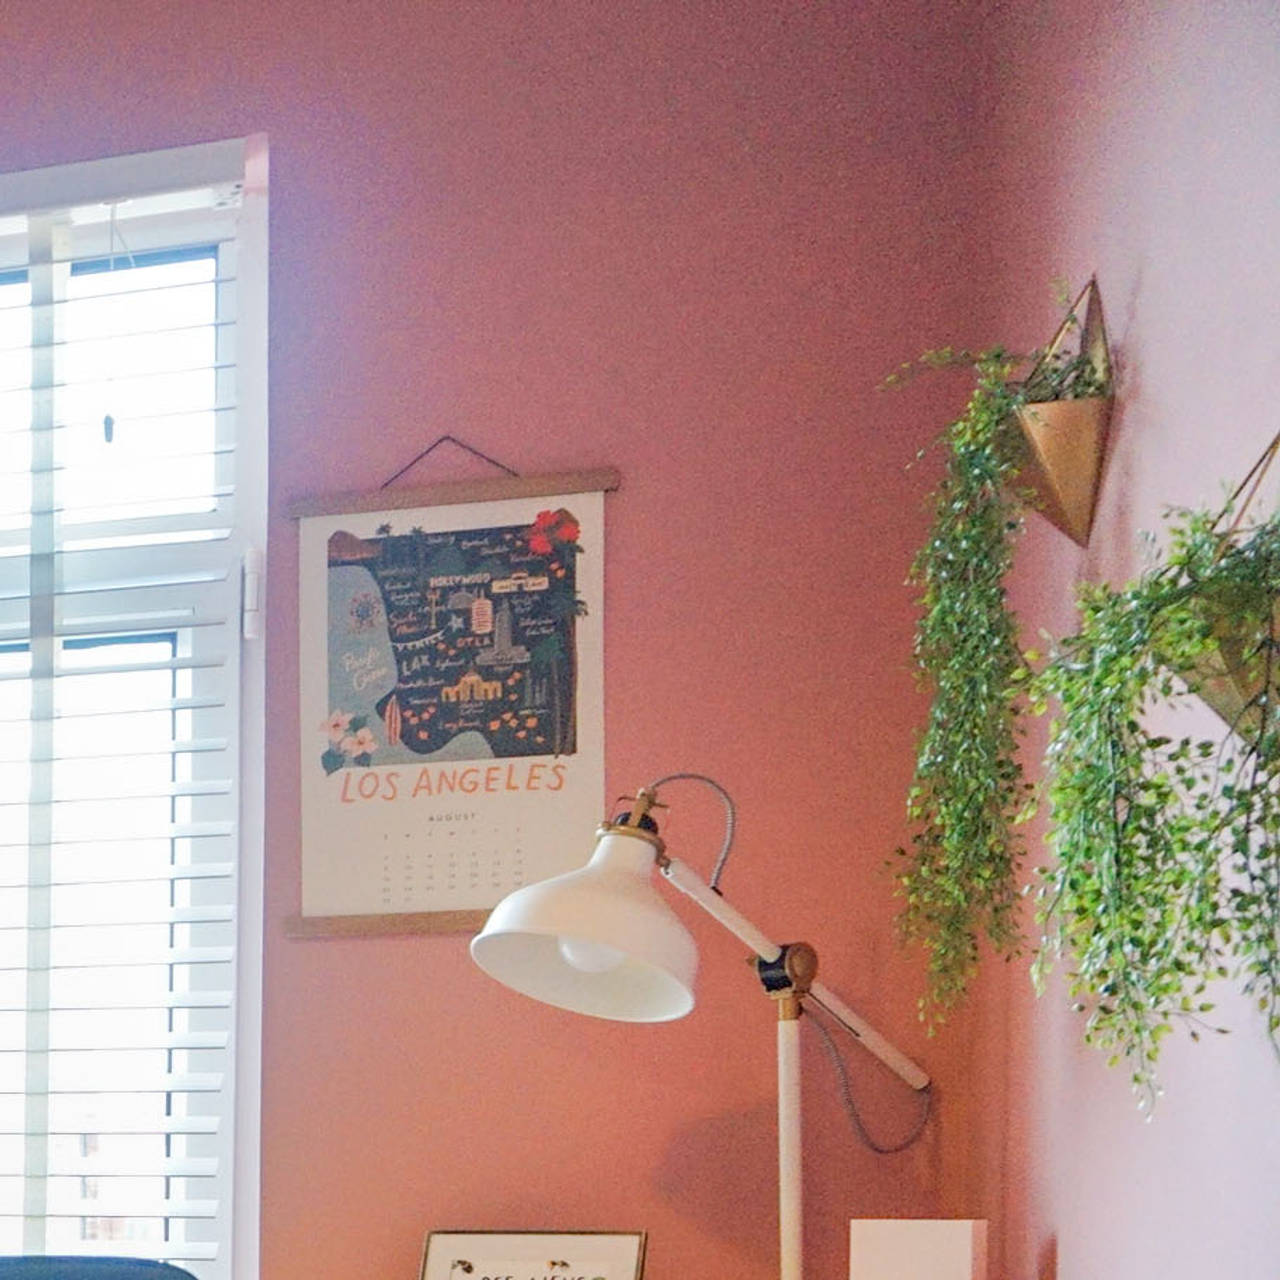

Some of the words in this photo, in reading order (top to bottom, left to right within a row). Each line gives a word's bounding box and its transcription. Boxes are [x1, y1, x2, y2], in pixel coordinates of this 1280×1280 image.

[402, 655, 430, 676] LAX
[339, 769, 401, 803] LOS
[412, 763, 567, 799] ANGELES
[427, 811, 477, 823] AUGUST
